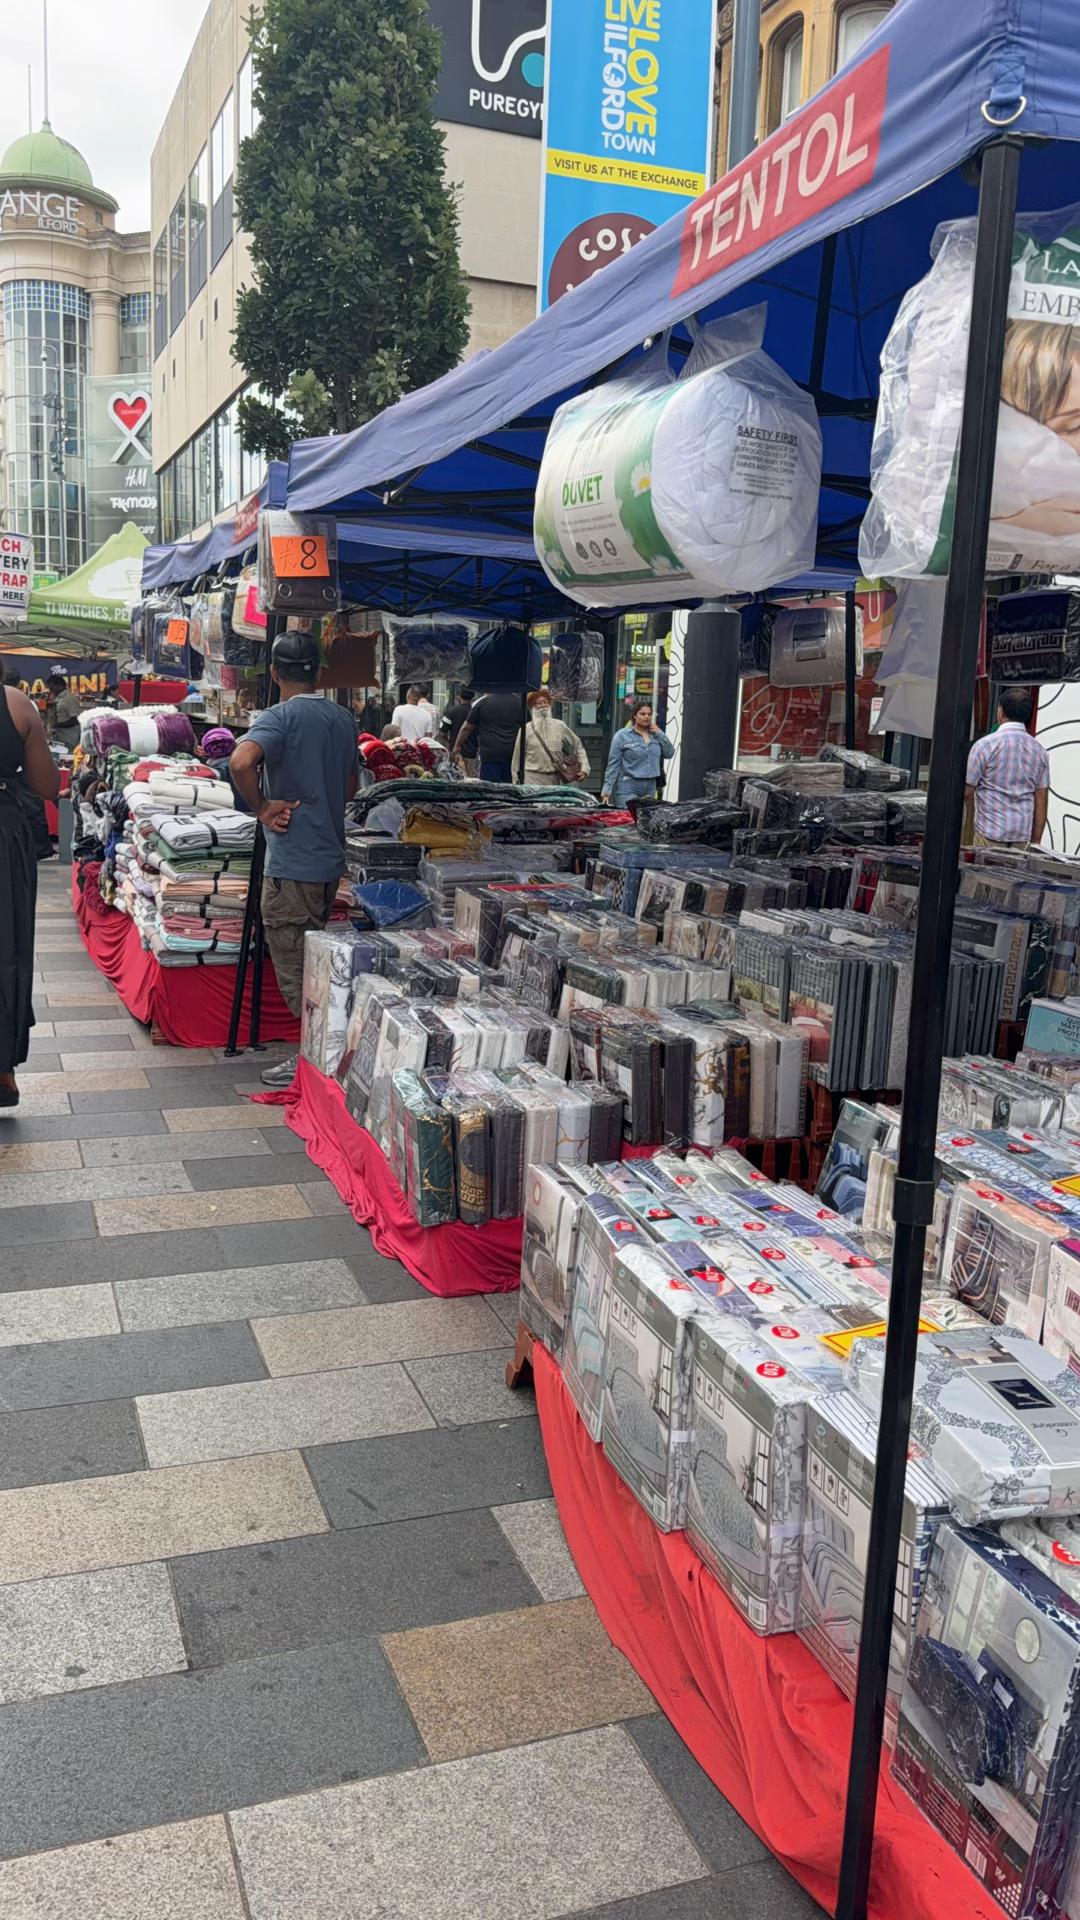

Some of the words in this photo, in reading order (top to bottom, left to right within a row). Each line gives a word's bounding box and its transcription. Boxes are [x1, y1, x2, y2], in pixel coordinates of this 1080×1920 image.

[605, 0, 660, 29] LIVE
[602, 23, 628, 131] ILFORD
[626, 28, 660, 137] LOVE
[469, 88, 543, 120] PUREGY
[601, 131, 656, 156] TOWN
[554, 158, 581, 171] VISIT
[584, 163, 598, 174] US
[600, 166, 615, 176] AT
[617, 168, 638, 180] THE
[640, 172, 698, 190] EXCHANGE
[690, 93, 868, 270] TENTOL
[0, 189, 80, 222] ANGE
[38, 217, 79, 234] ILFORD
[579, 228, 648, 261] COS
[737, 425, 774, 440] SAFETY
[775, 431, 798, 443] FIRST
[562, 474, 603, 507] DUVET
[1, 538, 21, 553] CH
[279, 538, 317, 570] £8
[3, 591, 25, 601] HERE
[50, 665, 68, 675] The
